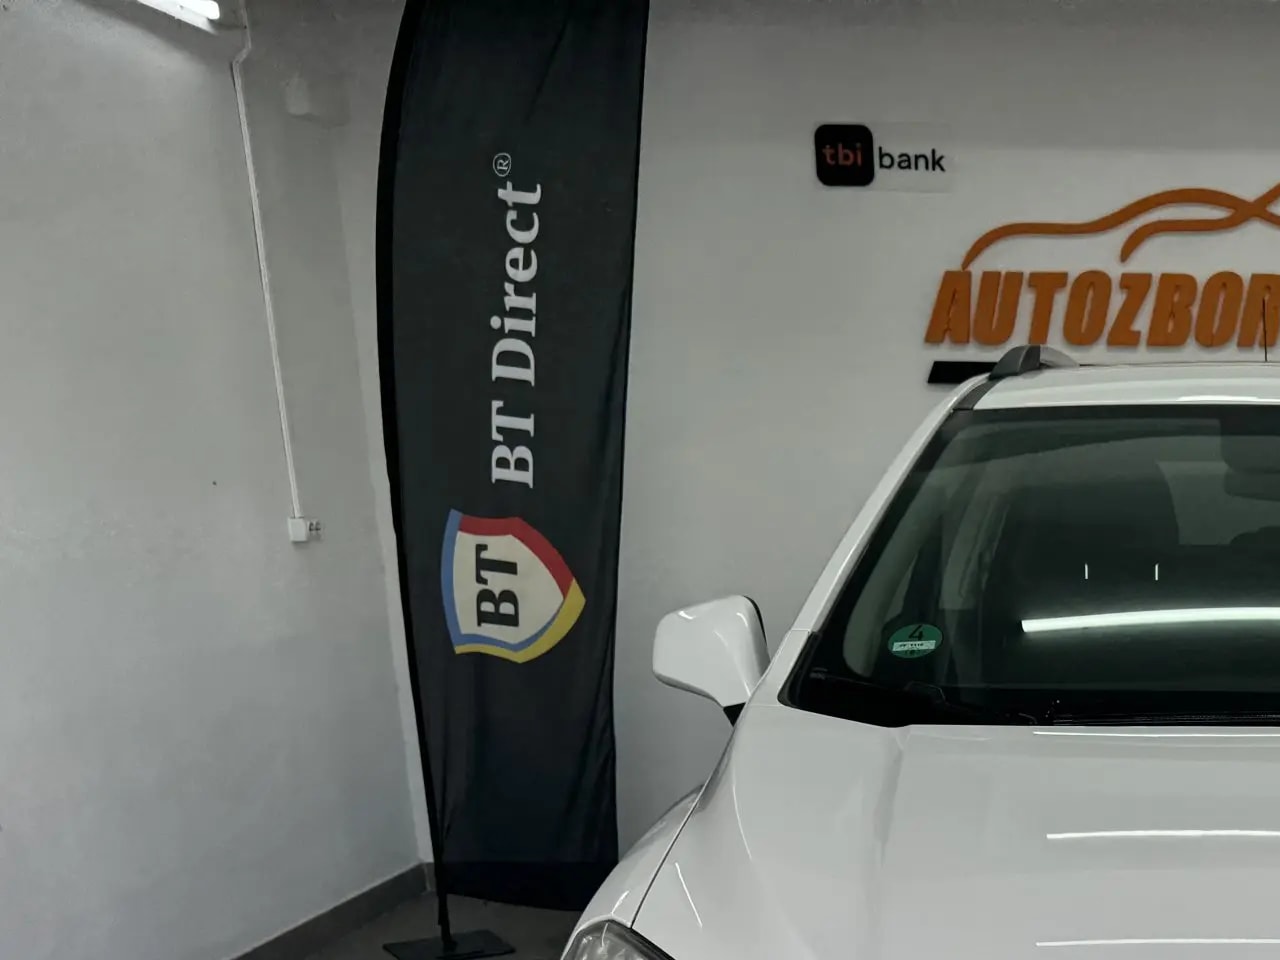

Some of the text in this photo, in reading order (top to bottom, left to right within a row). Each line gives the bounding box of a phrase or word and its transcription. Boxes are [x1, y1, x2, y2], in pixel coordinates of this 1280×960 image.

[822, 142, 946, 173] tbi bank
[491, 400, 535, 488] BT
[475, 543, 520, 628] BT
